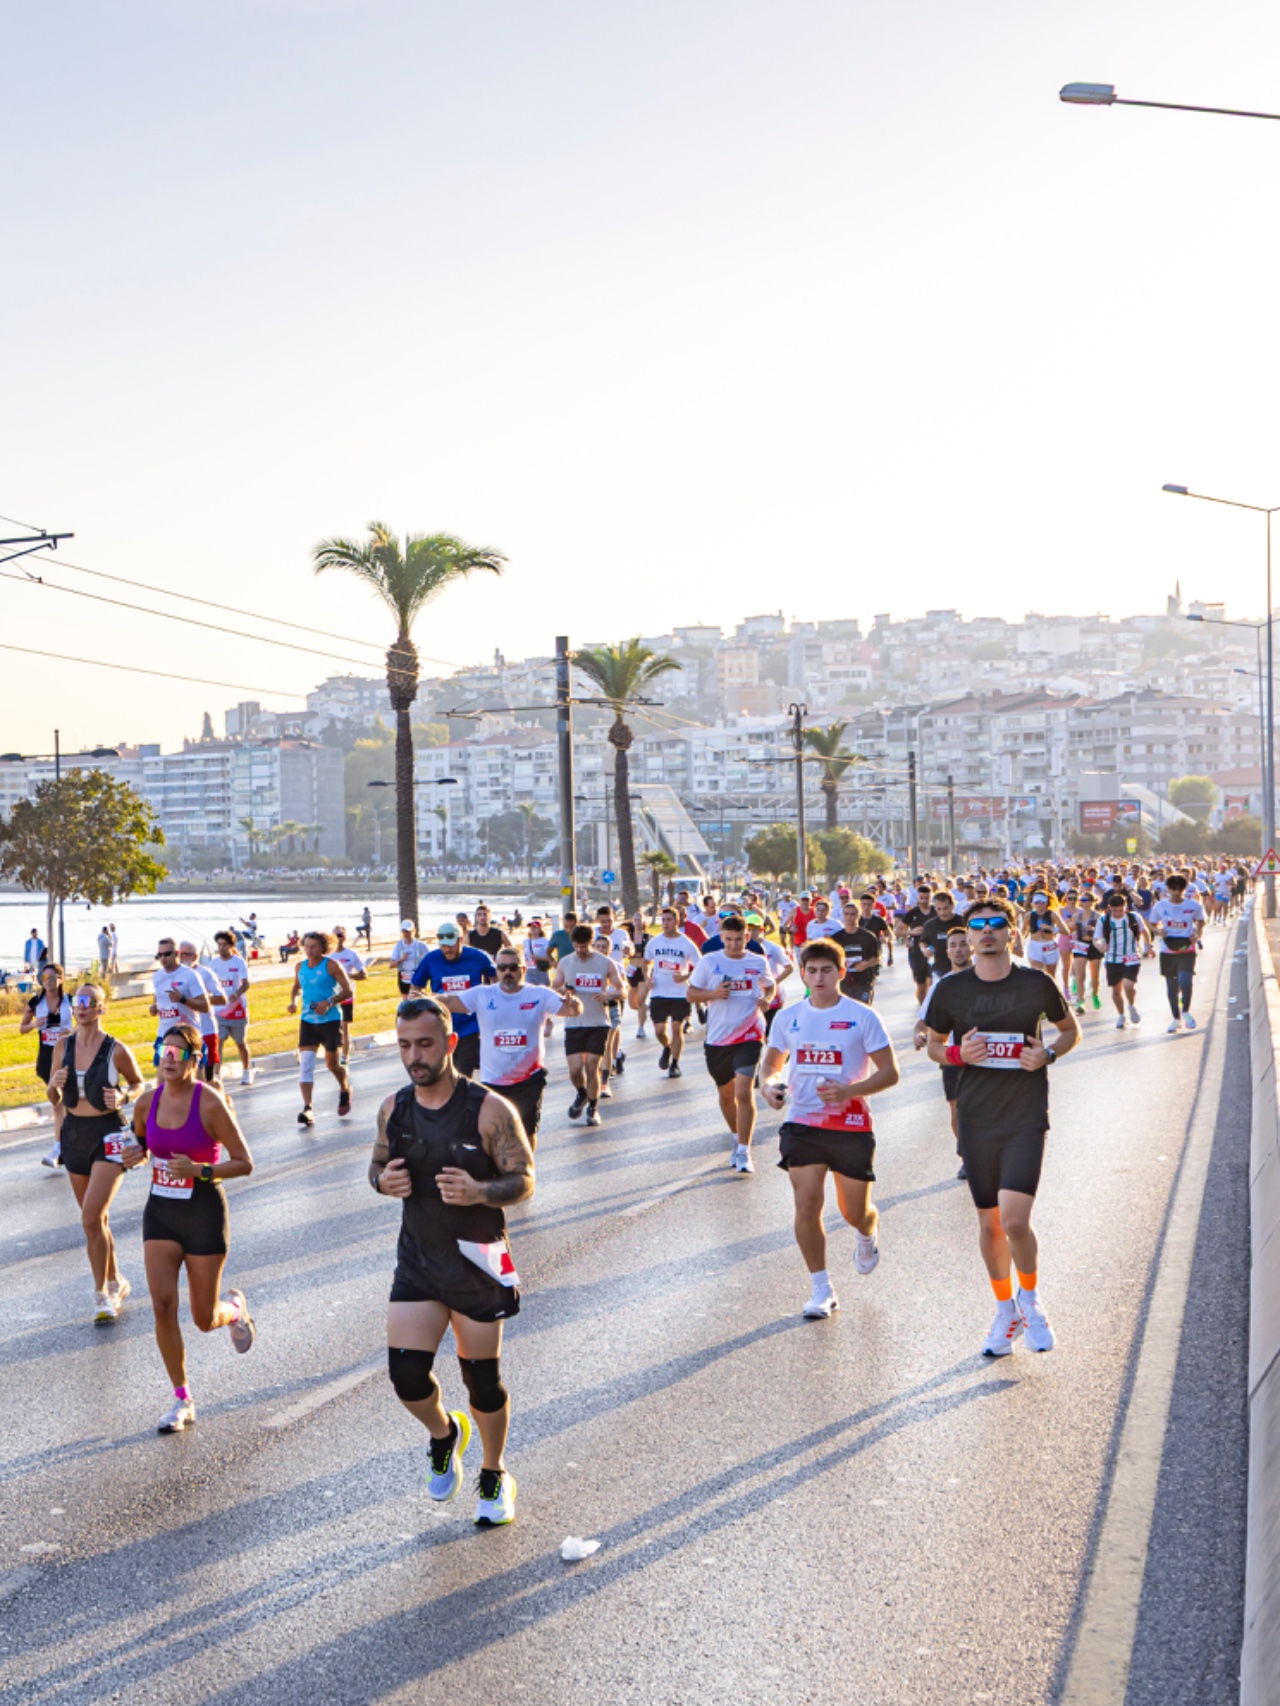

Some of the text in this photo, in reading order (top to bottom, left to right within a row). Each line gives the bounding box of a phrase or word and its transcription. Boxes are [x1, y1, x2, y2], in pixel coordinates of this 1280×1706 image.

[974, 991, 1017, 1013] RUN
[986, 1043, 1014, 1057] 507
[804, 1051, 836, 1063] 1723
[111, 1141, 124, 1153] 33
